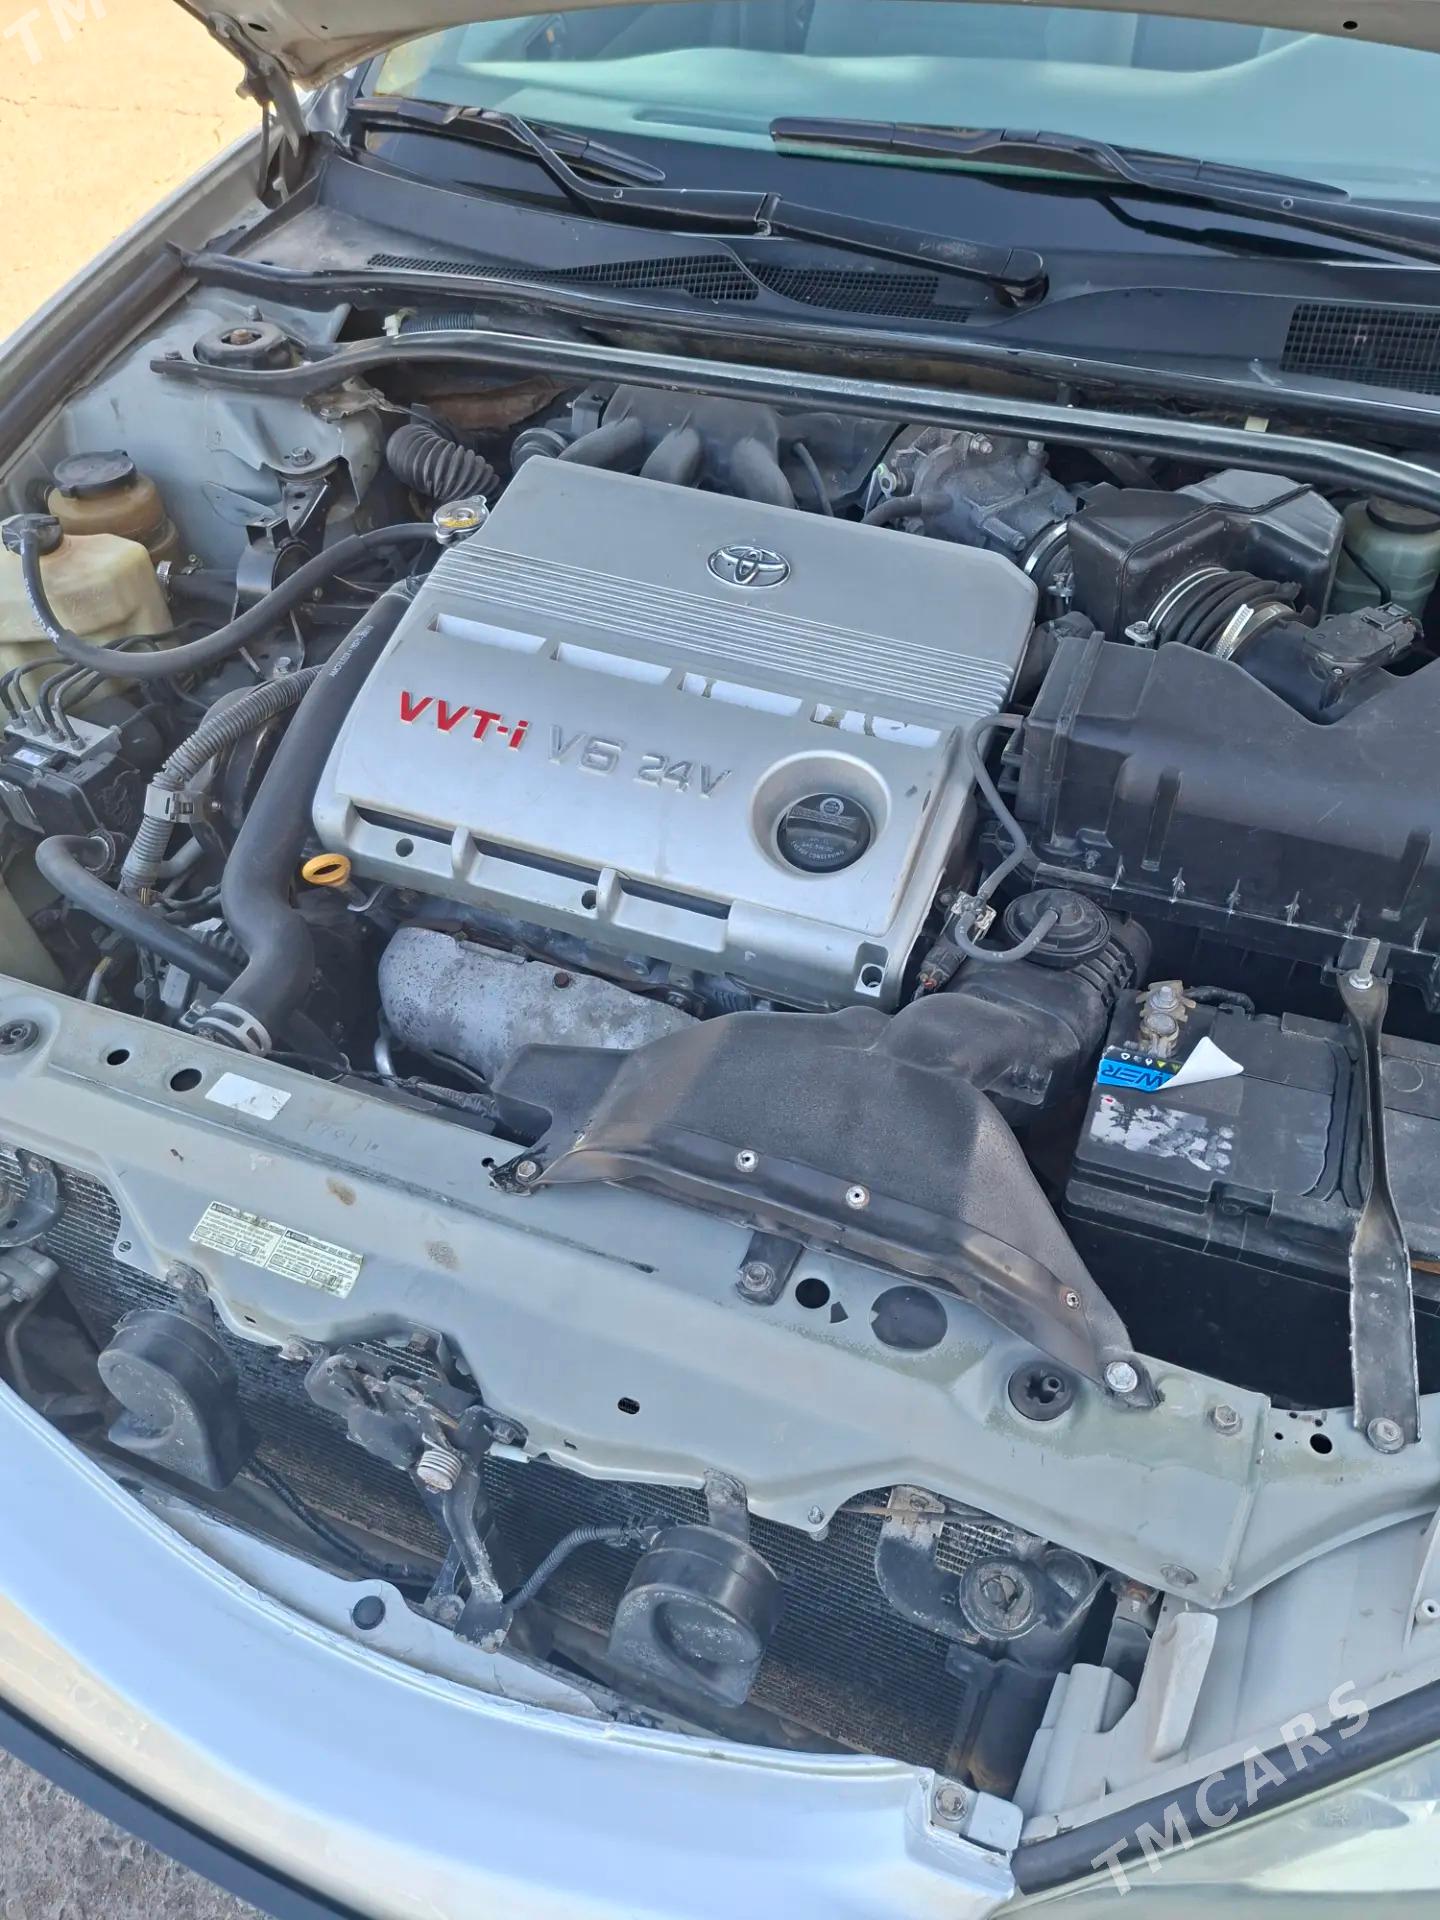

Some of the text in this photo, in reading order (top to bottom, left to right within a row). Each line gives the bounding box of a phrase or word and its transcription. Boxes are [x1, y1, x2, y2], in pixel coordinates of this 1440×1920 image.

[400, 690, 733, 799] VVT-i V6 24V
